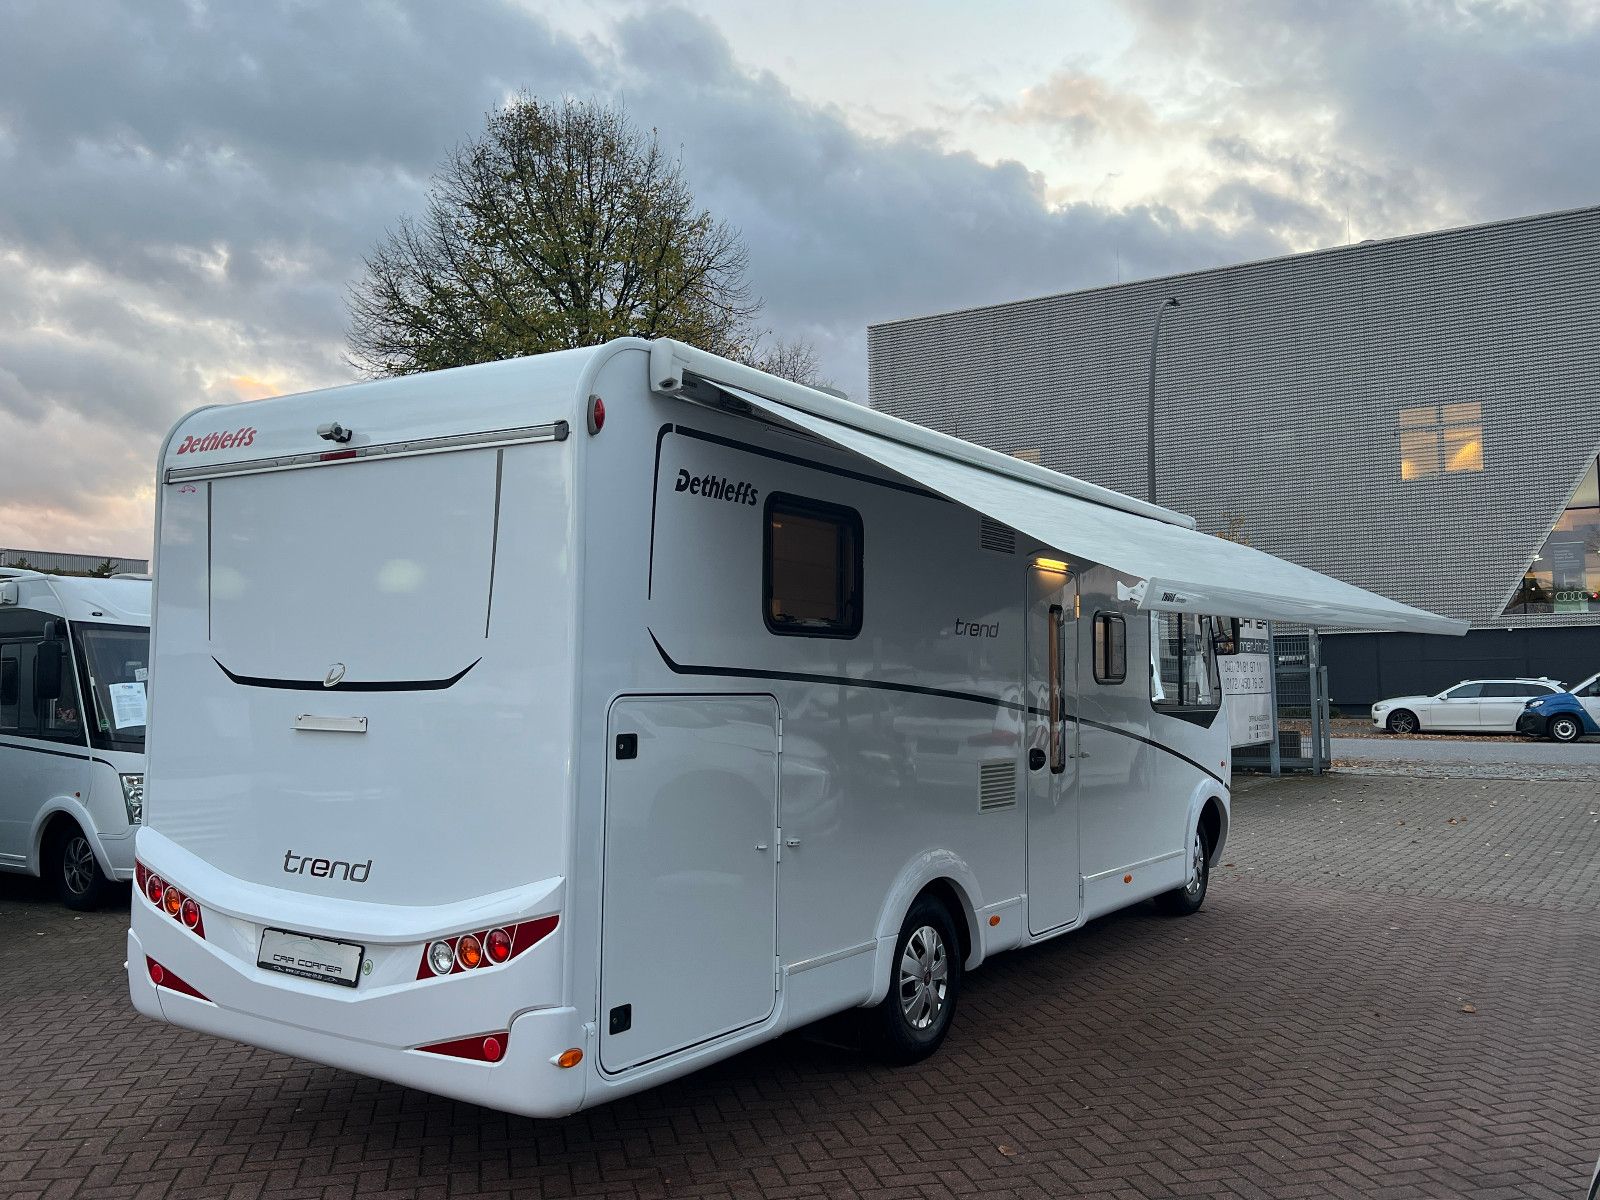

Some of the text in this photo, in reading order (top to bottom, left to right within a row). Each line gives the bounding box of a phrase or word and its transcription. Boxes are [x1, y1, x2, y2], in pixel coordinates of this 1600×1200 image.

[177, 426, 258, 455] Dethleffs
[675, 468, 759, 506] Dethleffs
[955, 617, 1000, 638] trend
[283, 849, 373, 883] trend
[273, 953, 342, 975] CAR CORNER
